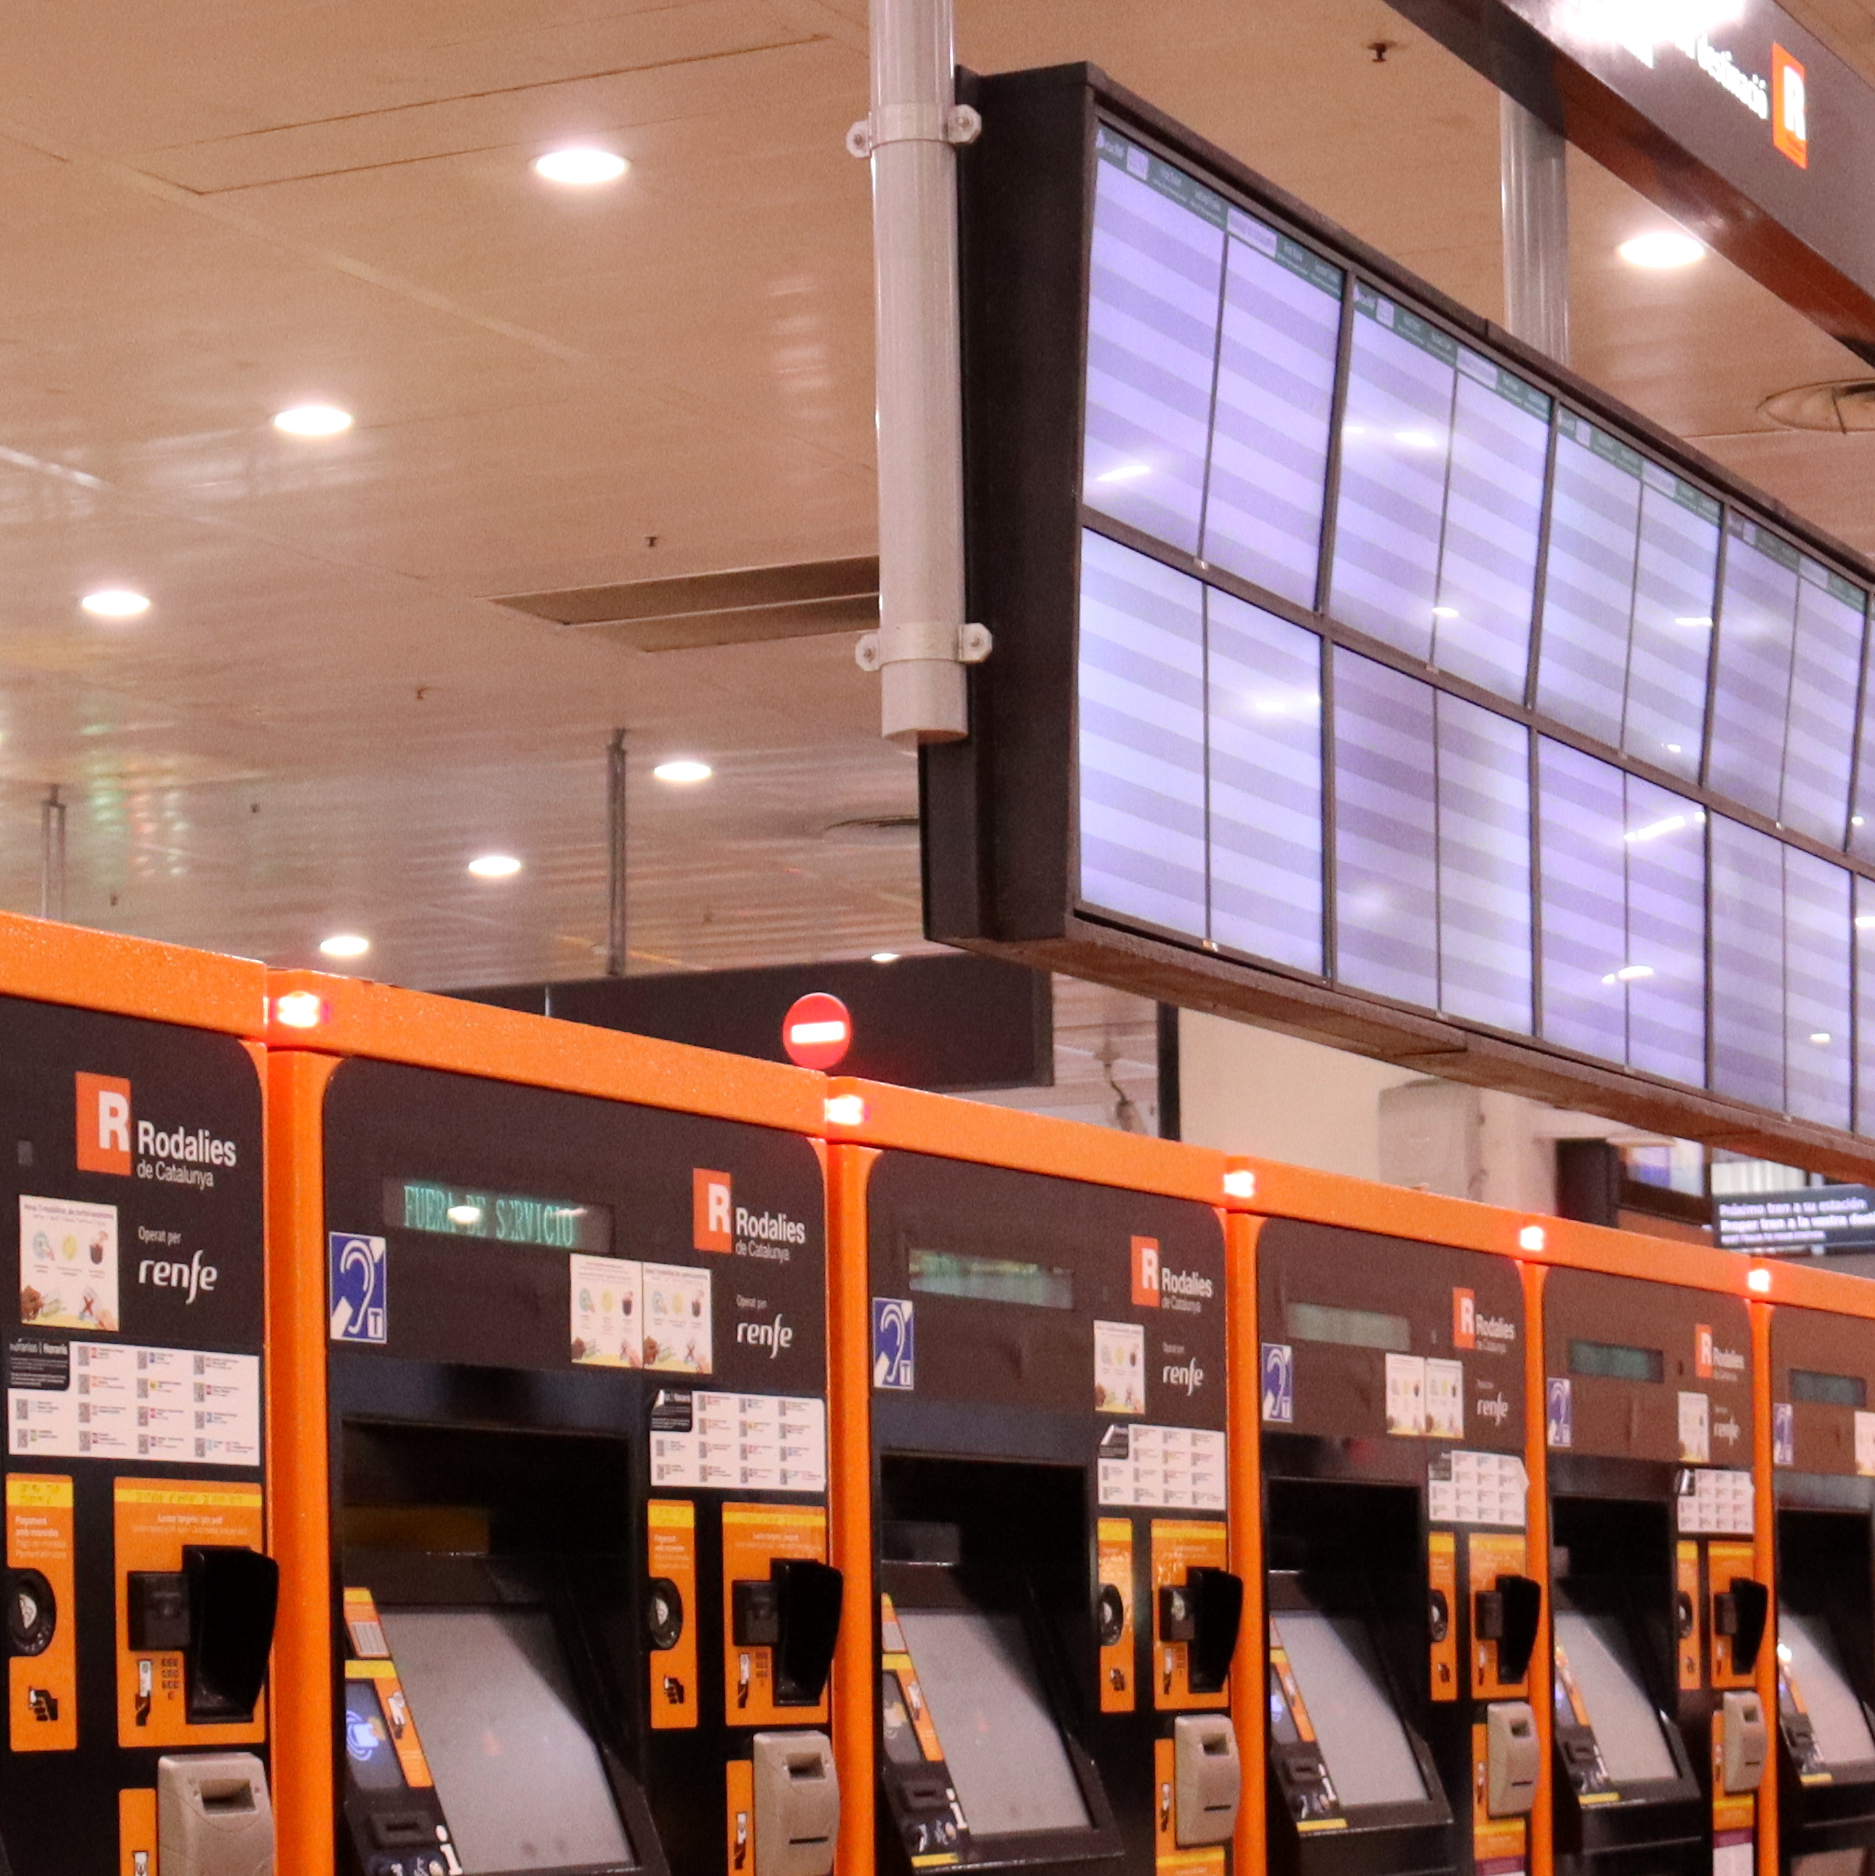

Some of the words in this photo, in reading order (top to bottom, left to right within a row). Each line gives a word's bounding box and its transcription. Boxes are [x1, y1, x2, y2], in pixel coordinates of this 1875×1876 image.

[1783, 65, 1807, 141] R
[99, 1090, 130, 1152] R
[138, 1120, 237, 1167] Rodalies
[137, 1159, 153, 1178] de
[156, 1161, 214, 1191] Catalunya
[708, 1183, 731, 1234] R
[736, 1206, 807, 1244] Rodalies
[138, 1225, 166, 1244] Operat
[167, 1229, 182, 1245] per
[735, 1239, 748, 1257] de
[138, 1250, 218, 1305] renfe
[1141, 1248, 1158, 1289] R
[1161, 1267, 1214, 1298] Rodalies
[1460, 1297, 1474, 1334] R
[736, 1313, 793, 1359] renfe
[1162, 1357, 1204, 1397] renfe
